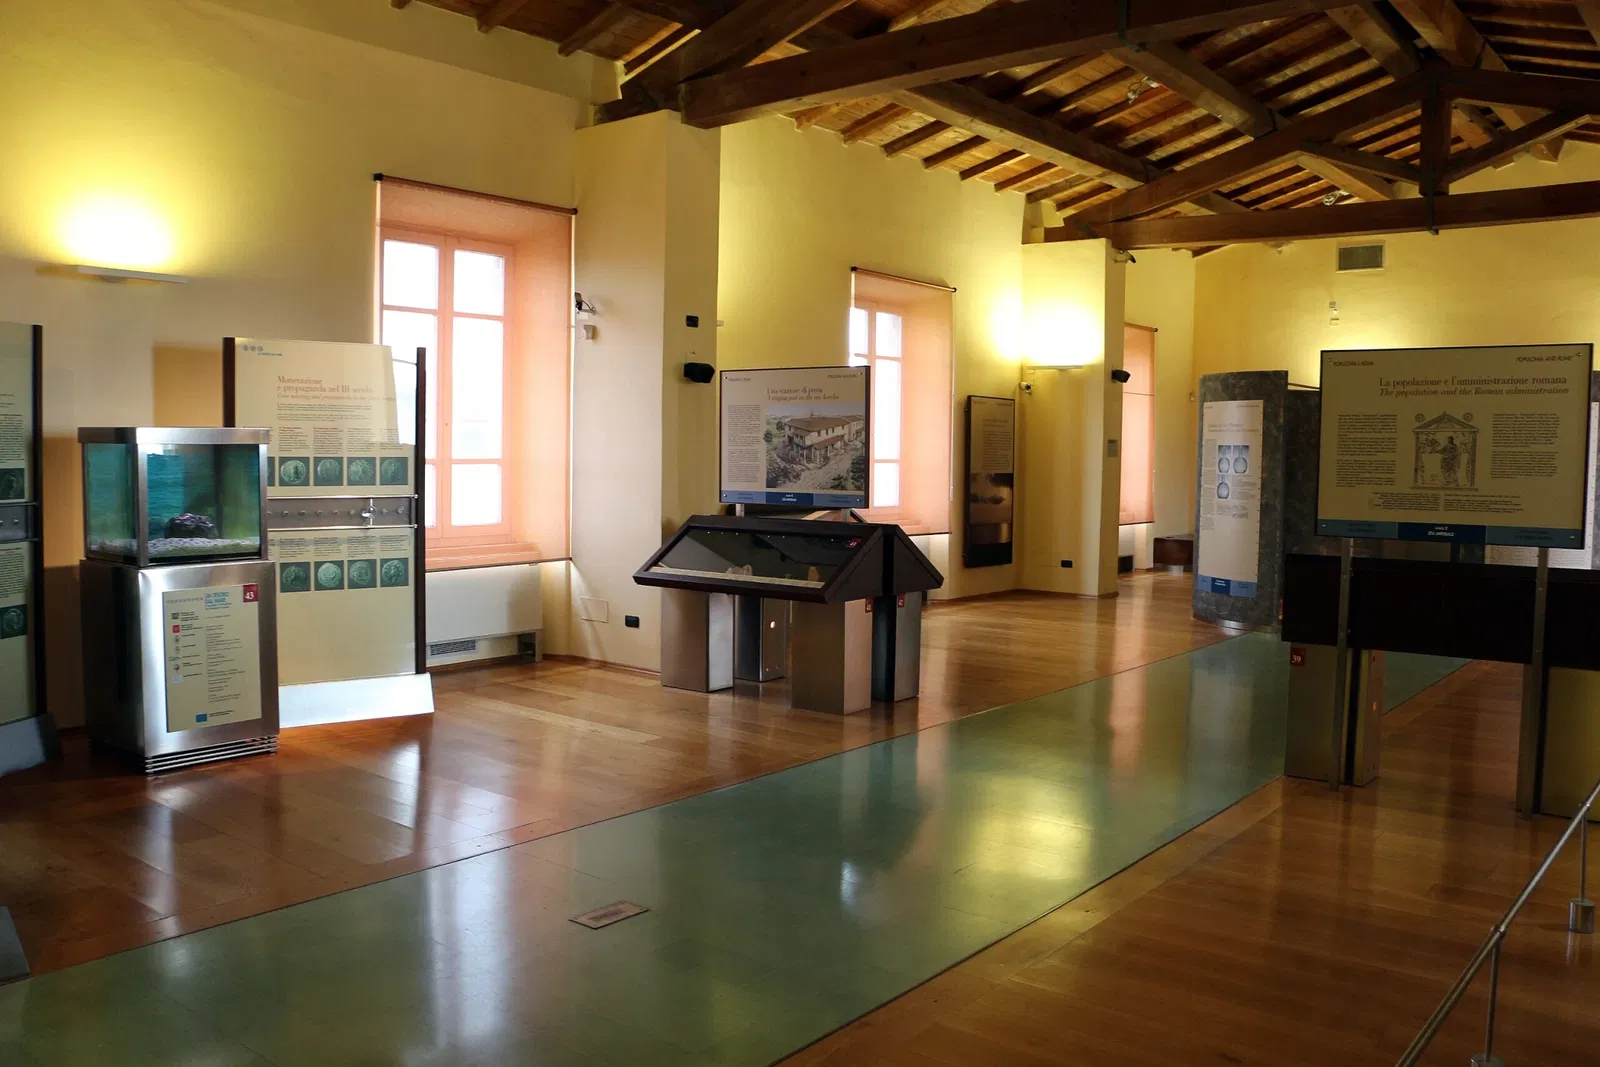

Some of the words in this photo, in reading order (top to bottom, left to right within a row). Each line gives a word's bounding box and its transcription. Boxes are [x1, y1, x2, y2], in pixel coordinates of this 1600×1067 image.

[277, 375, 323, 384] Monetazione
[1379, 377, 1390, 387] La
[1392, 376, 1442, 389] popolazione
[1451, 375, 1529, 386] l'amministrazione
[1532, 376, 1568, 385] romana
[283, 385, 326, 394] propaganda
[328, 385, 340, 393] nel
[801, 386, 807, 394] di
[808, 387, 823, 397] posta
[1379, 388, 1393, 396] The
[1395, 387, 1438, 399] population
[1440, 387, 1457, 396] and
[1459, 386, 1471, 396] the
[1474, 386, 1503, 396] Roman
[1506, 385, 1569, 395] administration
[245, 591, 254, 599] 43
[1292, 654, 1301, 663] 39
